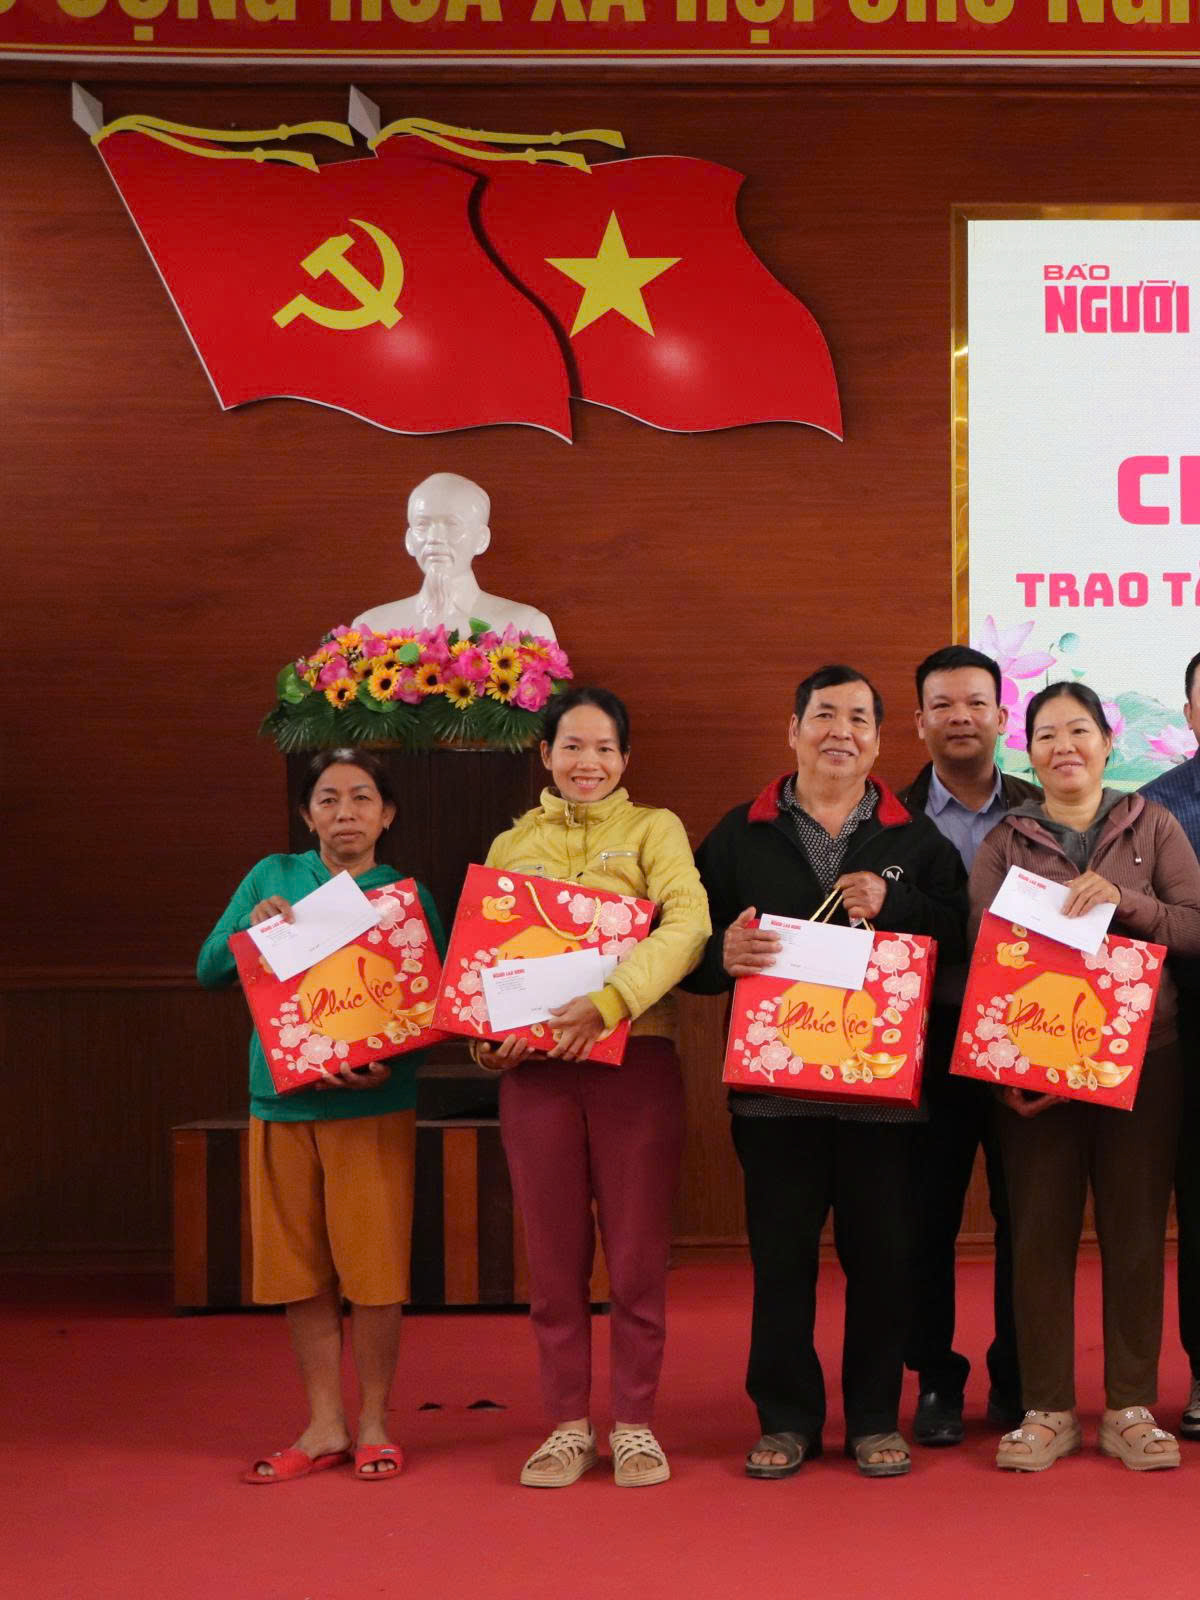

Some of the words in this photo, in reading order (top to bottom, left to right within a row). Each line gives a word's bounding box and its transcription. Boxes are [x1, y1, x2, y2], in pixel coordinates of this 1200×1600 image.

[1043, 264, 1111, 280] BÁO
[1044, 280, 1190, 334] NGƯỜI
[1015, 572, 1150, 608] TRAO
